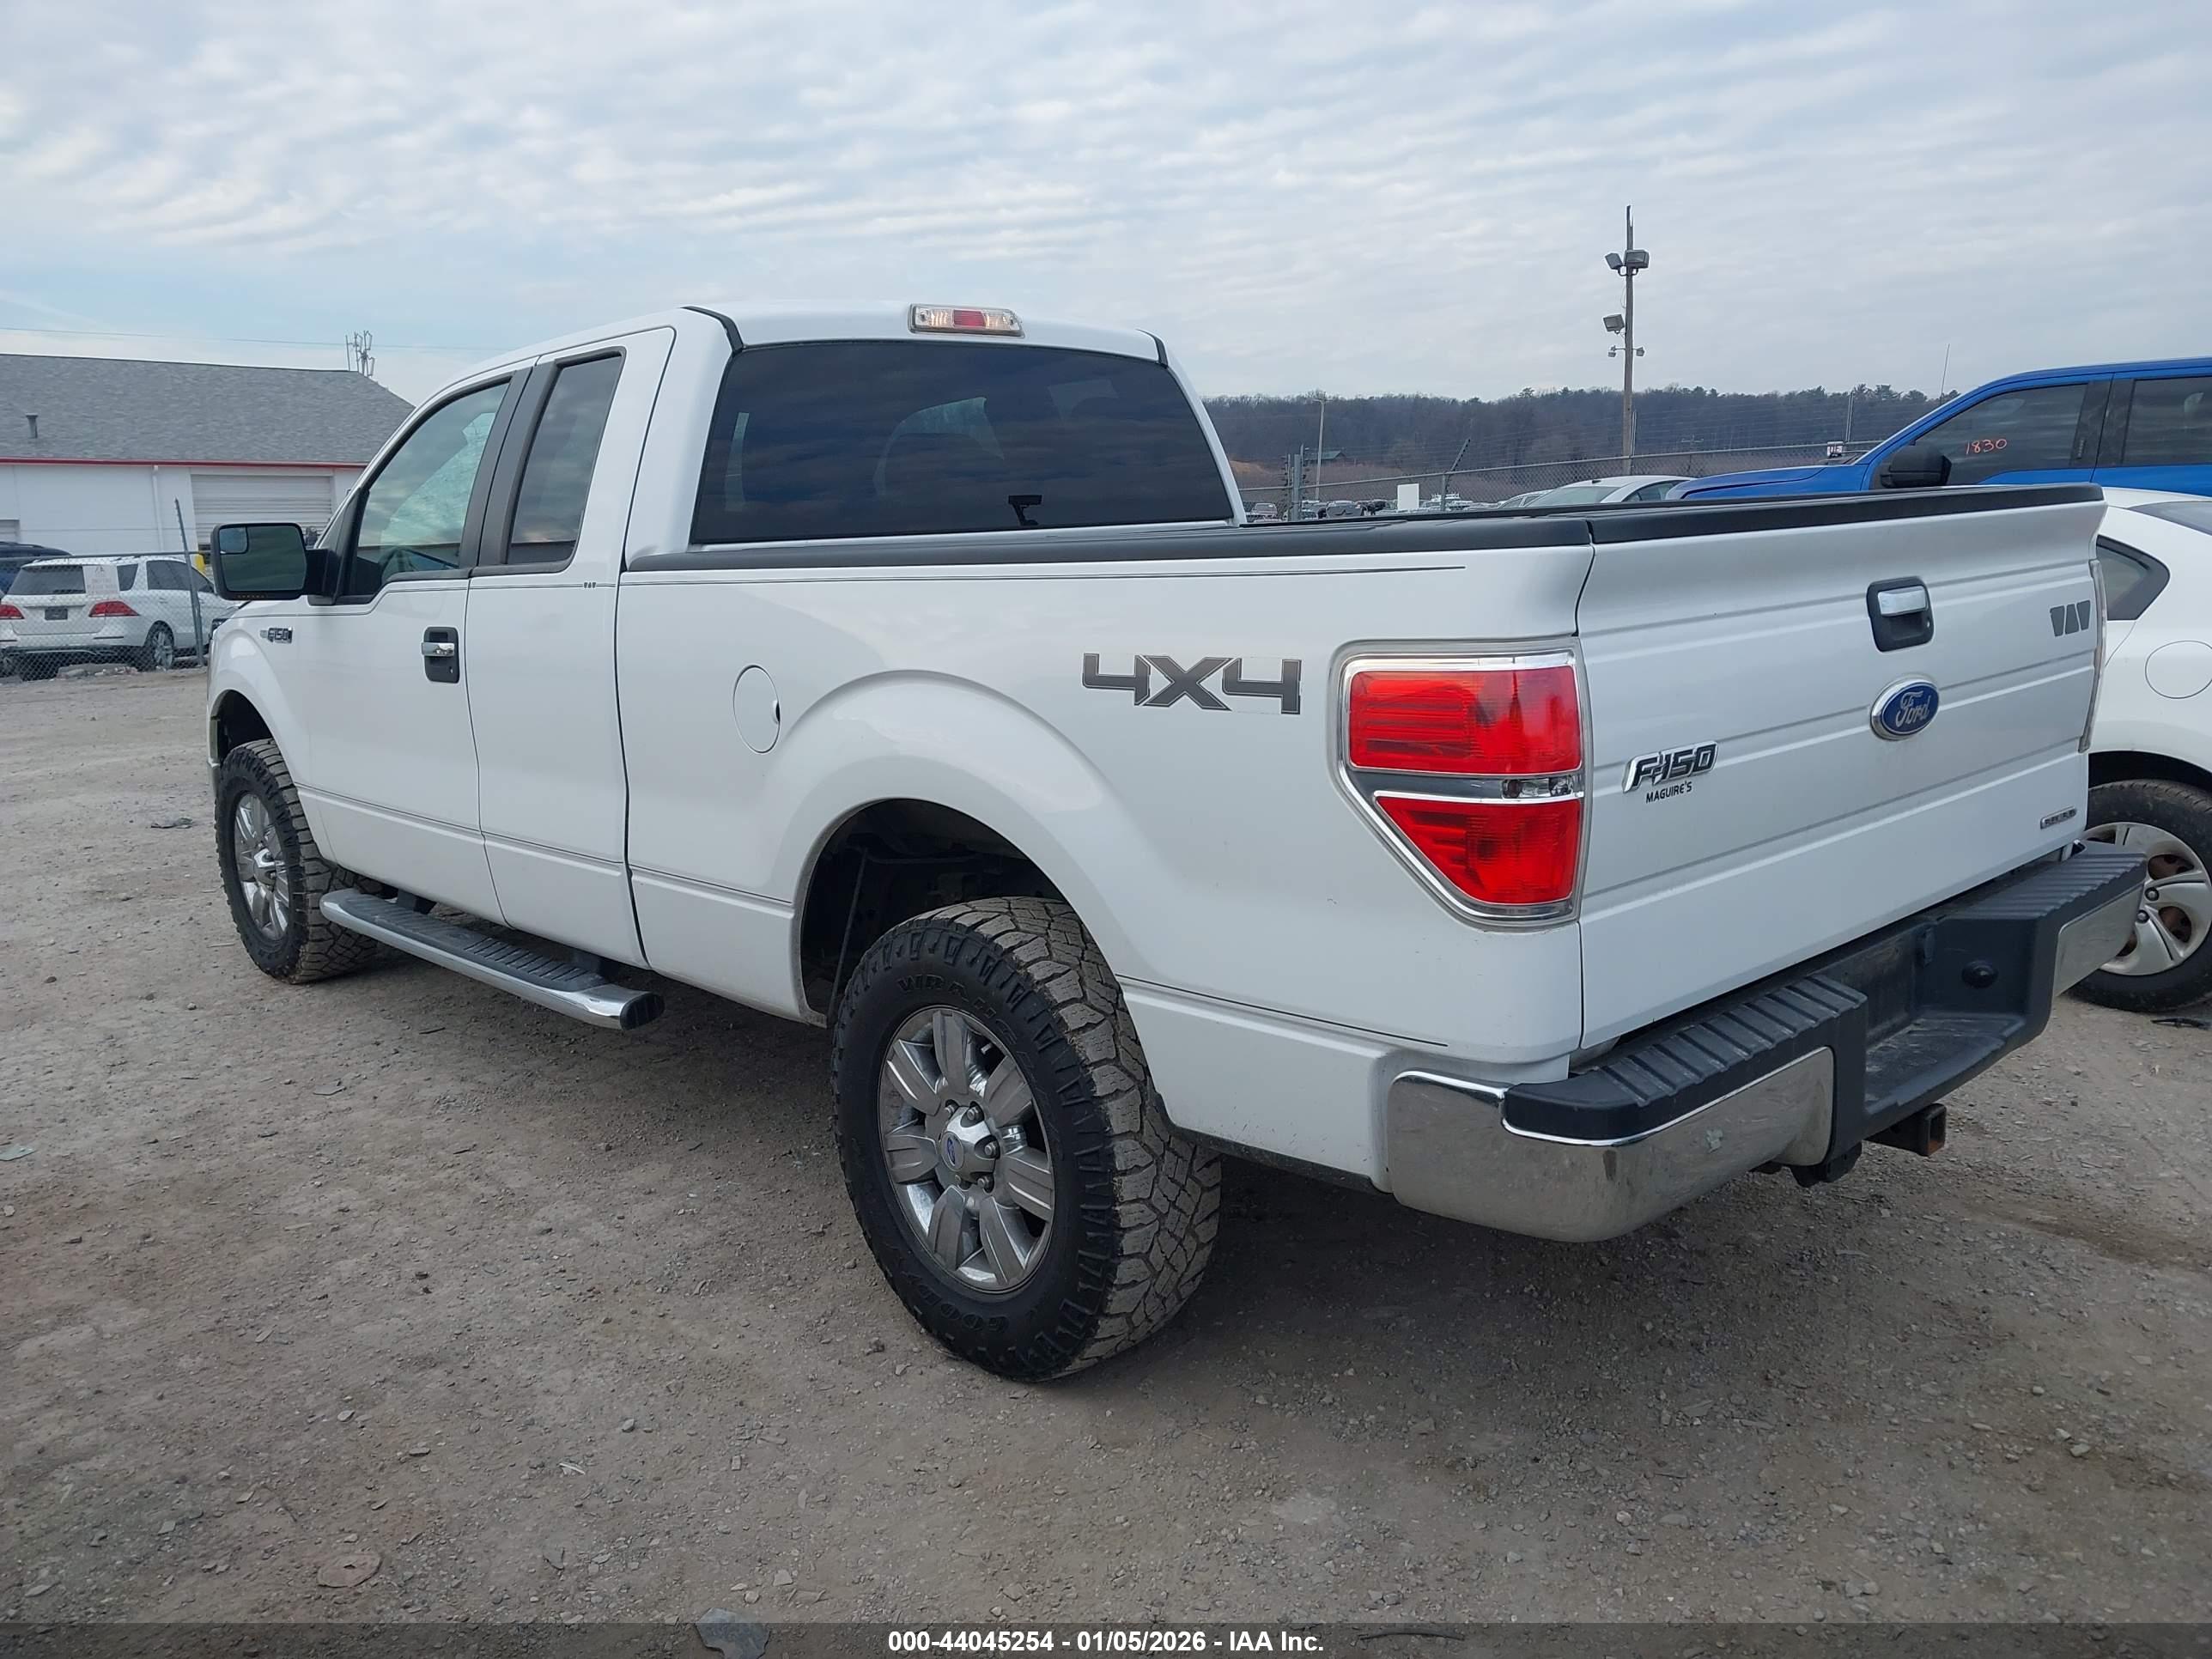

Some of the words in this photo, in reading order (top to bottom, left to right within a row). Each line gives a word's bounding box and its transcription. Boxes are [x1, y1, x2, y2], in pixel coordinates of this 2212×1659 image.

[1966, 439, 2008, 454] 1830
[1895, 690, 1932, 728] Ford
[1645, 781, 1693, 804] MAGUIRE'S
